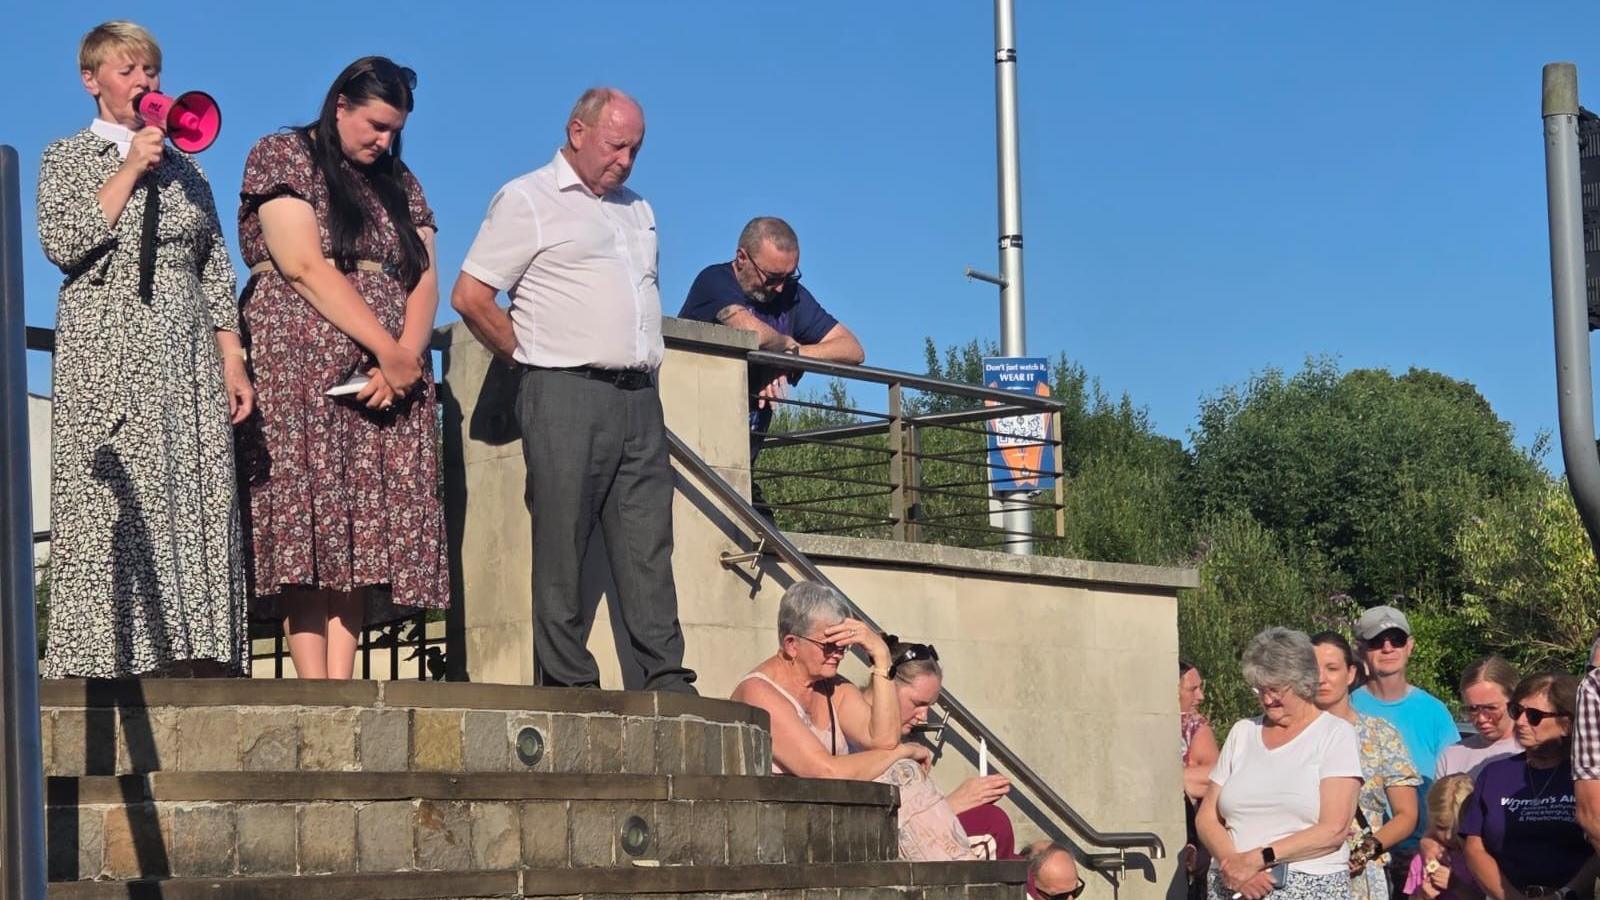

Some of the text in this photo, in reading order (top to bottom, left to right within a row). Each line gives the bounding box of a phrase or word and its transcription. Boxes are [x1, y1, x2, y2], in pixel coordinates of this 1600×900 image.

[1006, 363, 1018, 372] just
[1020, 363, 1039, 371] watch
[999, 373, 1034, 381] WEAR IT
